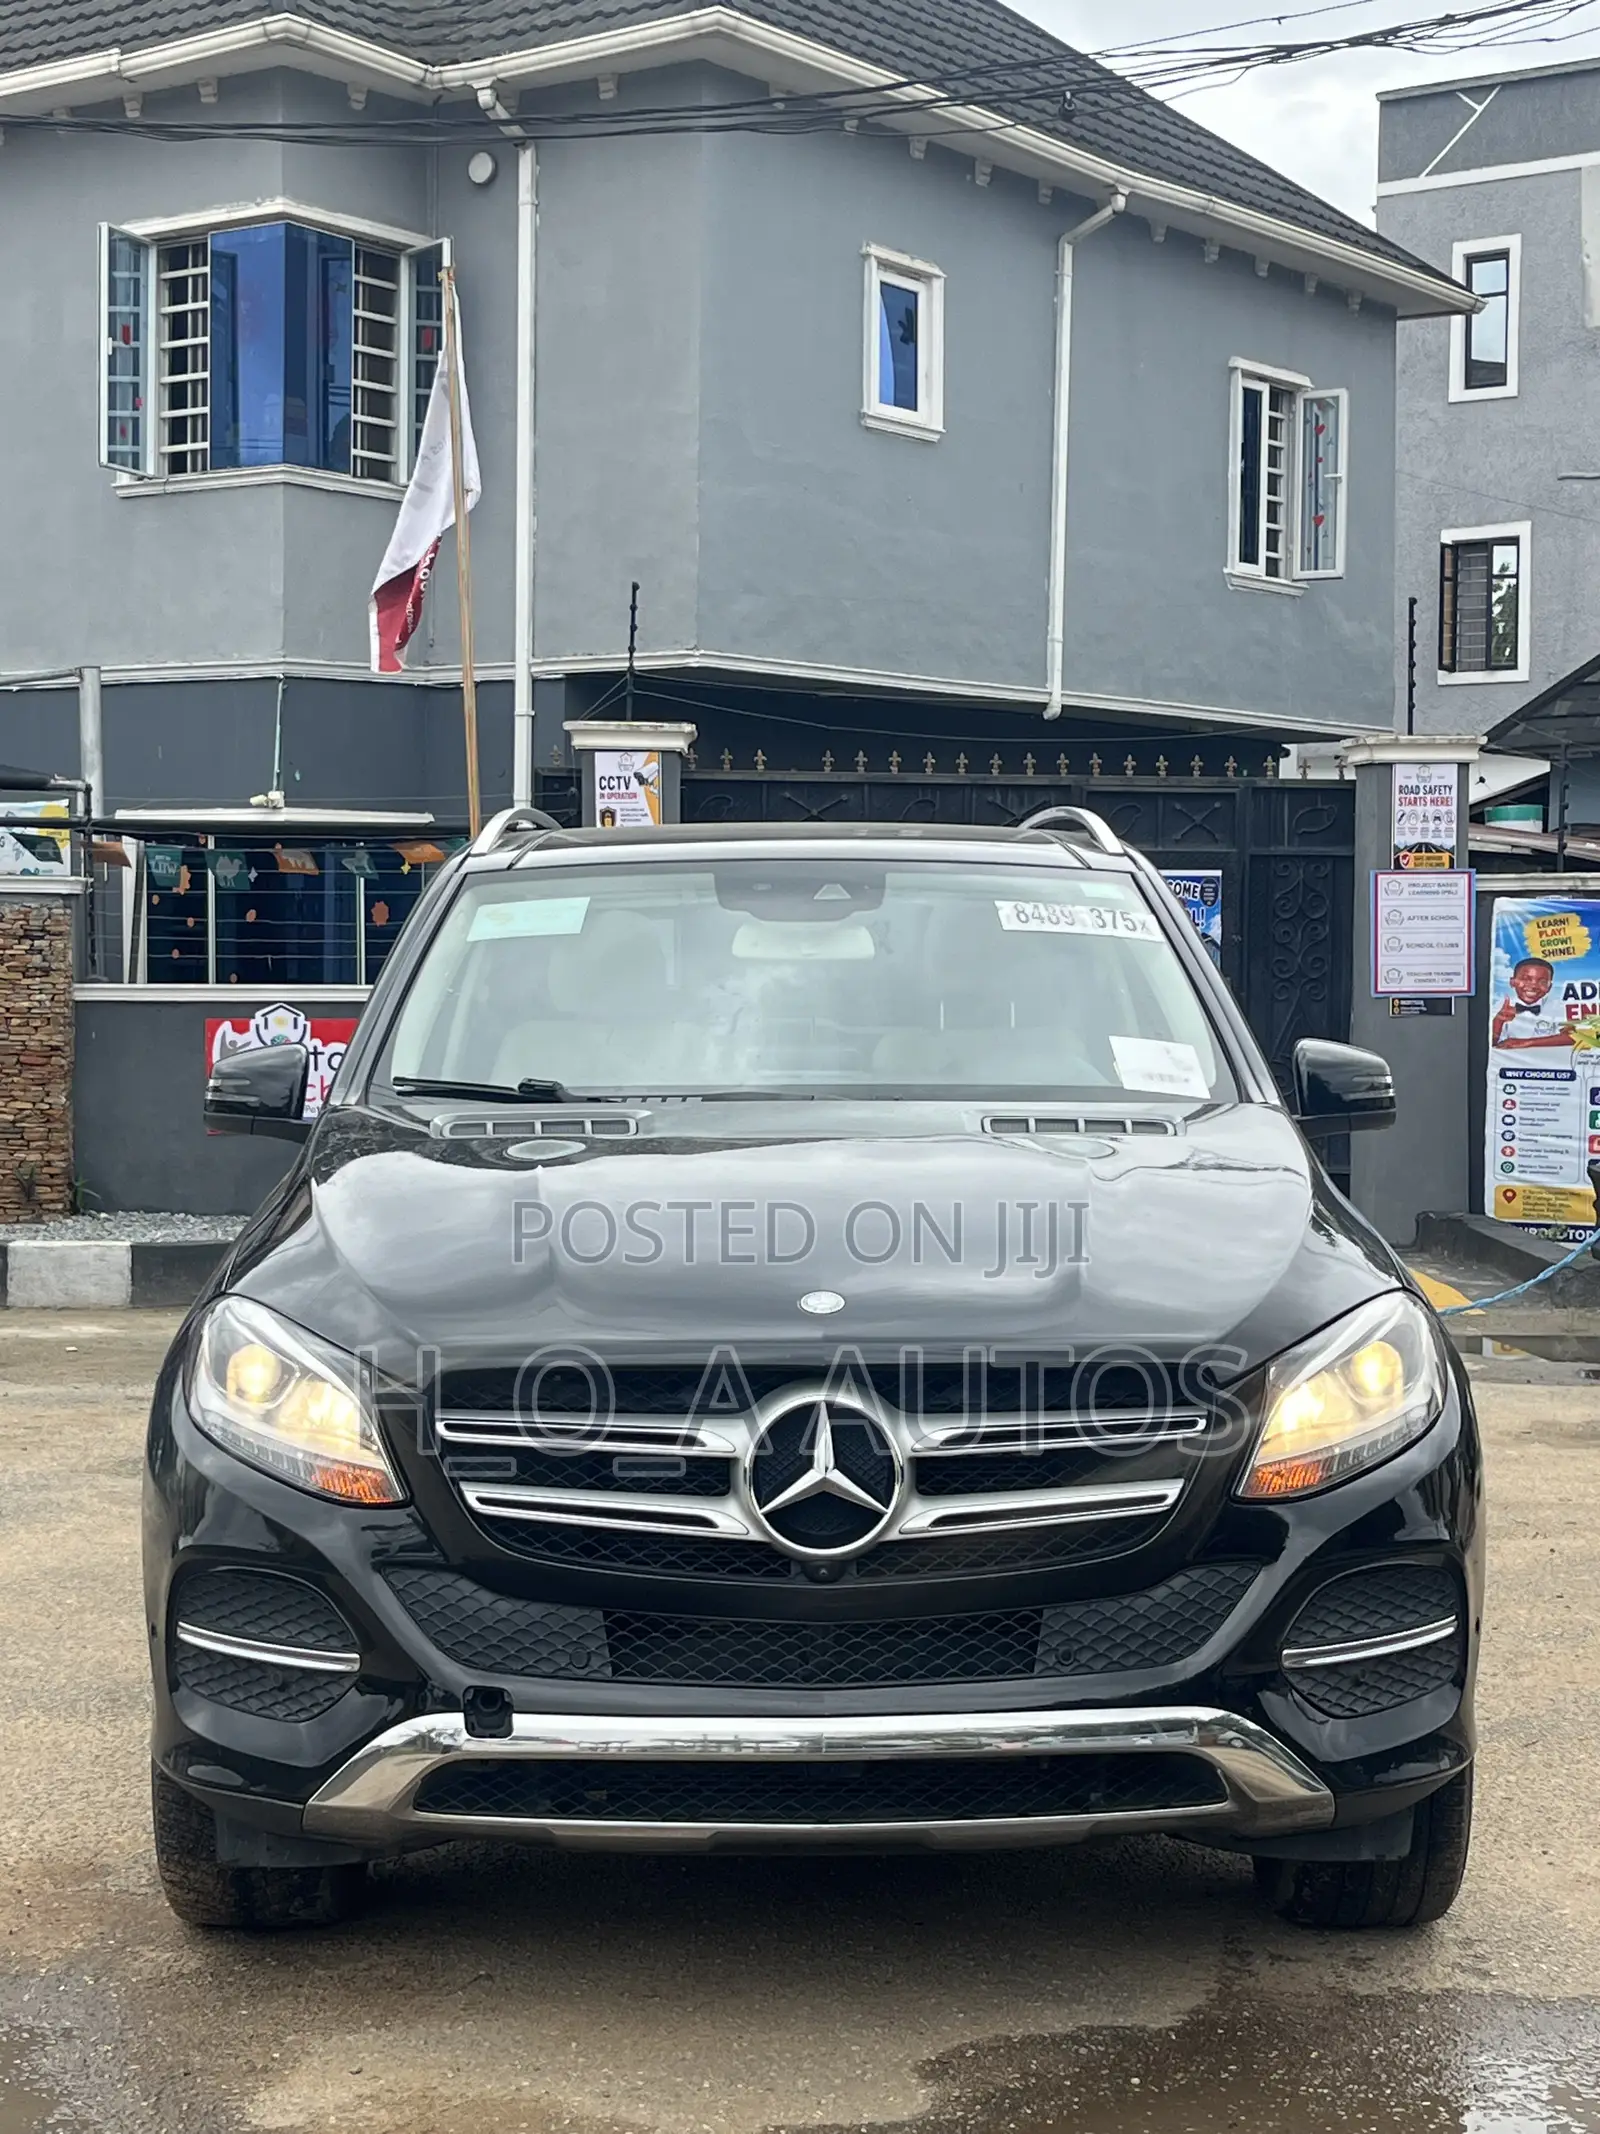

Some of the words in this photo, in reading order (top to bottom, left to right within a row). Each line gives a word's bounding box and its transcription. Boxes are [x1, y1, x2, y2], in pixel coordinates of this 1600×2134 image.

[599, 775, 631, 790] CCTV
[1398, 784, 1421, 796] ROAD
[1422, 784, 1453, 796] SAFETY
[1398, 796, 1428, 807] STARTS
[1429, 796, 1453, 807] HERE!
[1536, 917, 1570, 929] LEARN!
[1538, 927, 1566, 938] PLAY!
[1540, 936, 1572, 948] GROW!
[1541, 946, 1576, 958] SHINE!
